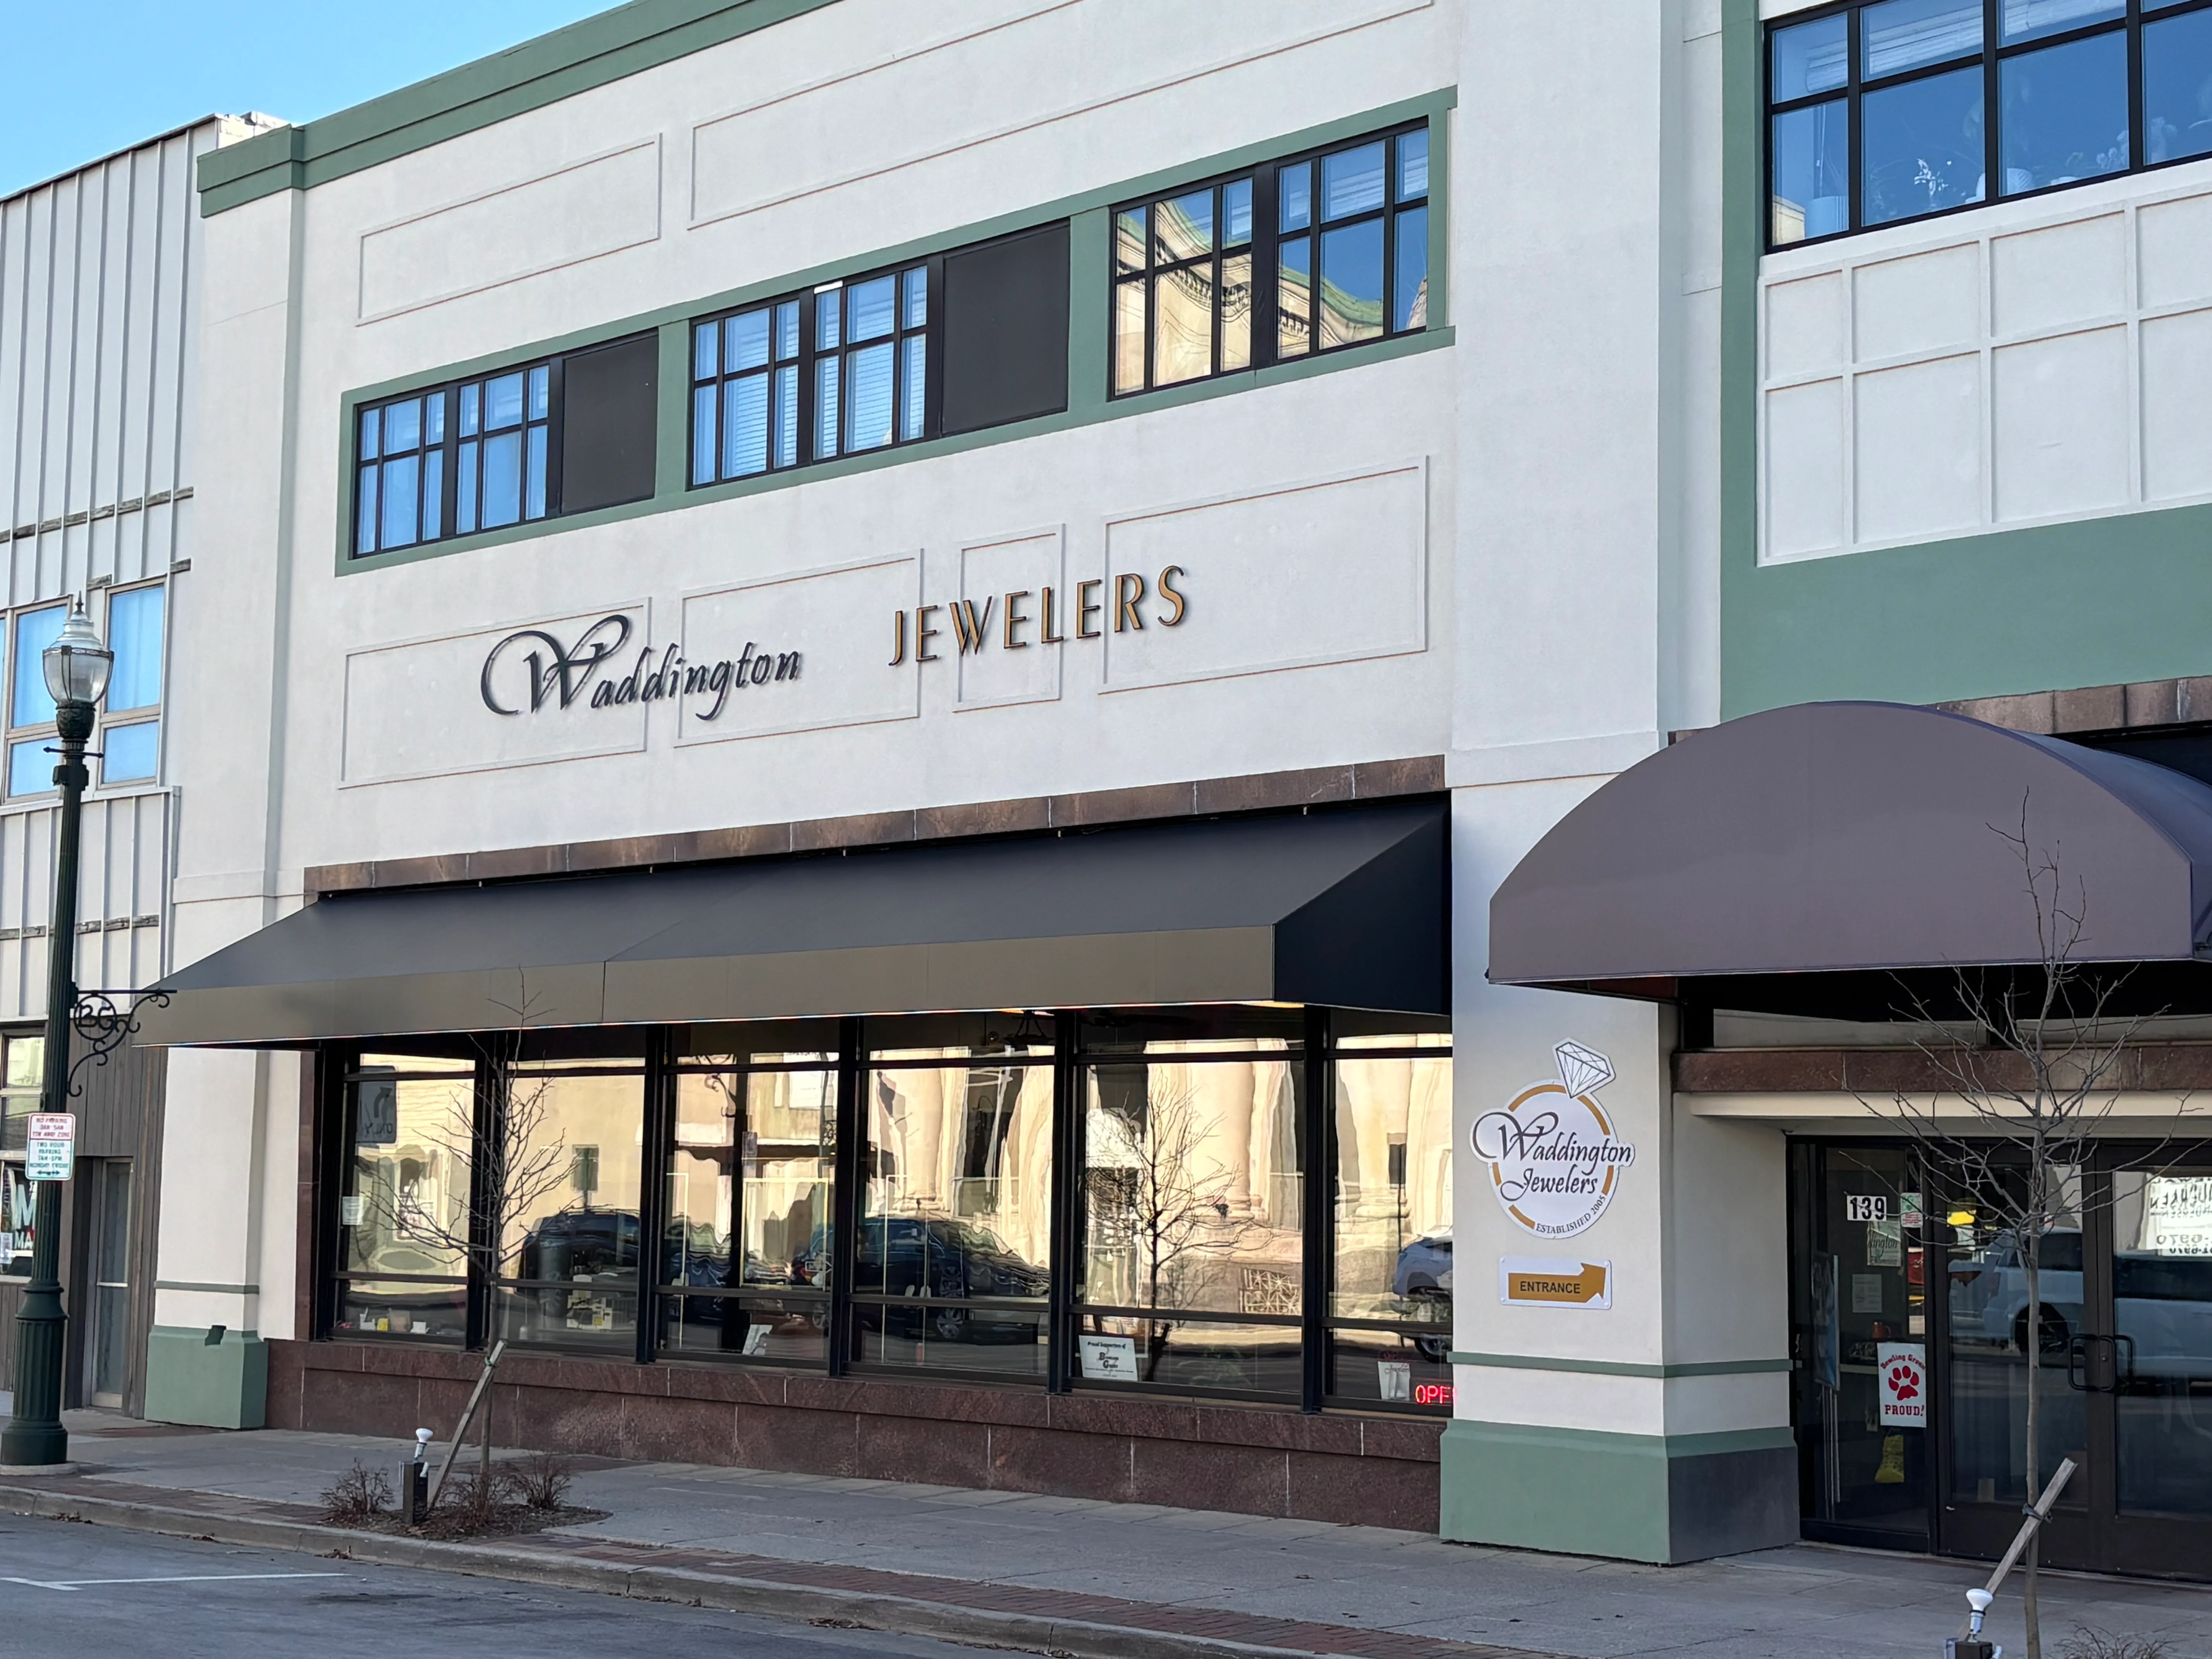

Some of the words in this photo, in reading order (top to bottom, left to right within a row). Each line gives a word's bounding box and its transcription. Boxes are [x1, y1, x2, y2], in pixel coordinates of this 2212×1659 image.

[888, 565, 1185, 666] JEWELERS
[480, 614, 800, 721] Waddington
[1472, 1112, 1631, 1176] Waddington
[1500, 1164, 1598, 1201] Jewelers
[1536, 1212, 1591, 1234] ESTABLISHED
[1590, 1195, 1606, 1215] 2005
[1850, 1197, 1885, 1220] 139
[1520, 1281, 1581, 1294] ENTRANCE
[1885, 1405, 1924, 1417] PROUD!
